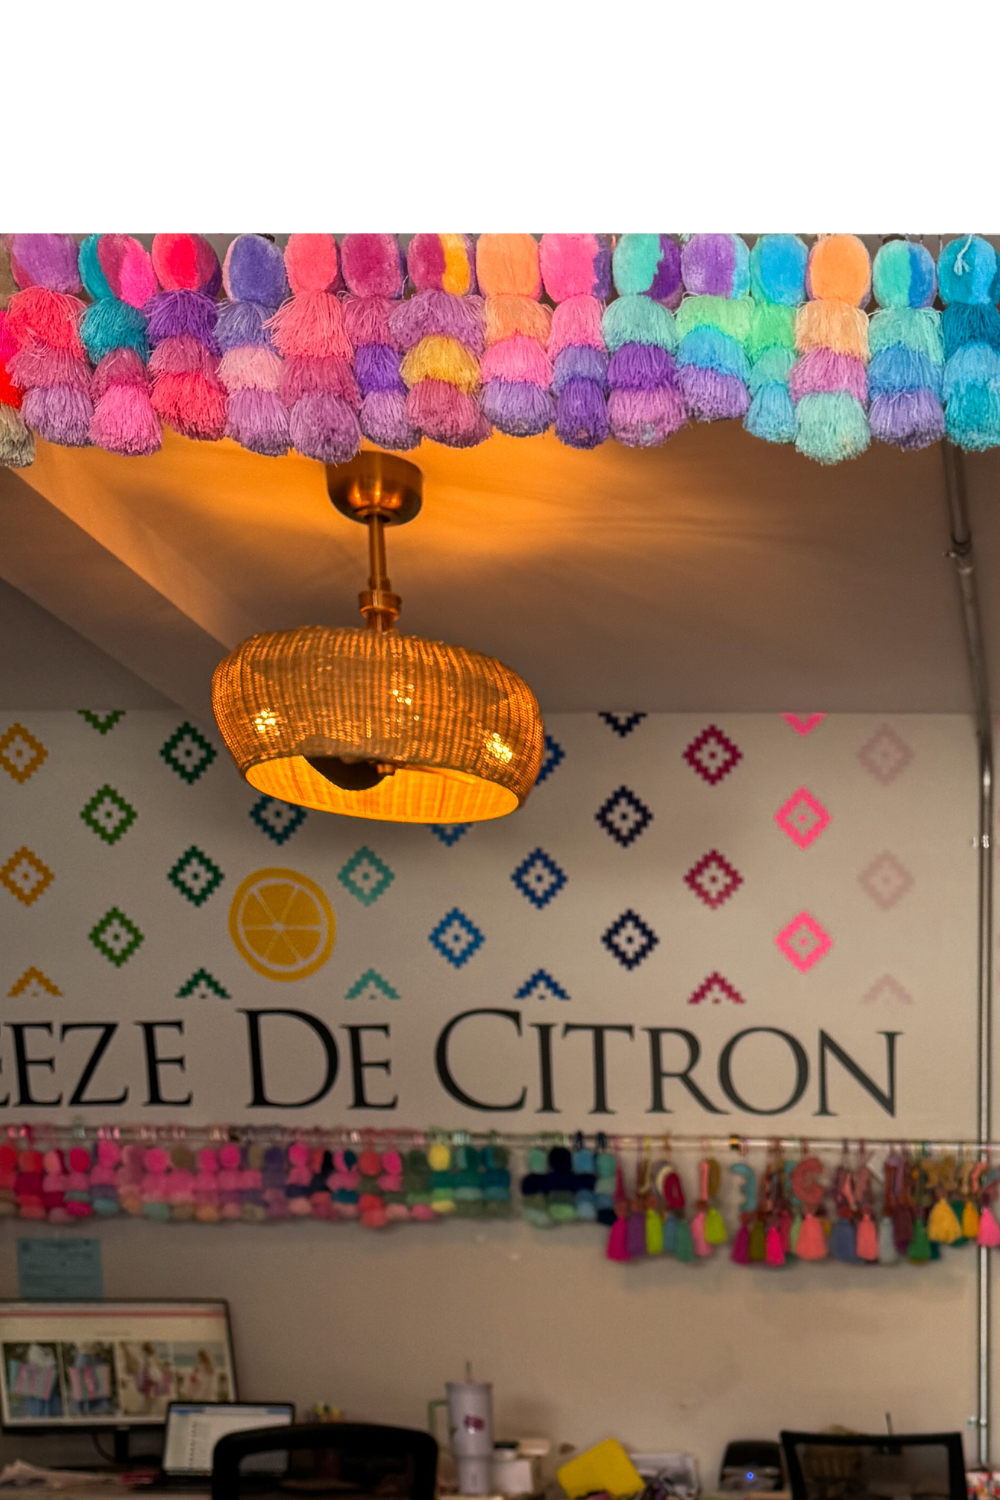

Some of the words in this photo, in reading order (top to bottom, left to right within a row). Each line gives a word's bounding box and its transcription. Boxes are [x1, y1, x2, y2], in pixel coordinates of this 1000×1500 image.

[0, 1020, 195, 1109] EZE
[238, 1007, 399, 1112] DE
[434, 1008, 899, 1116] CITRON
